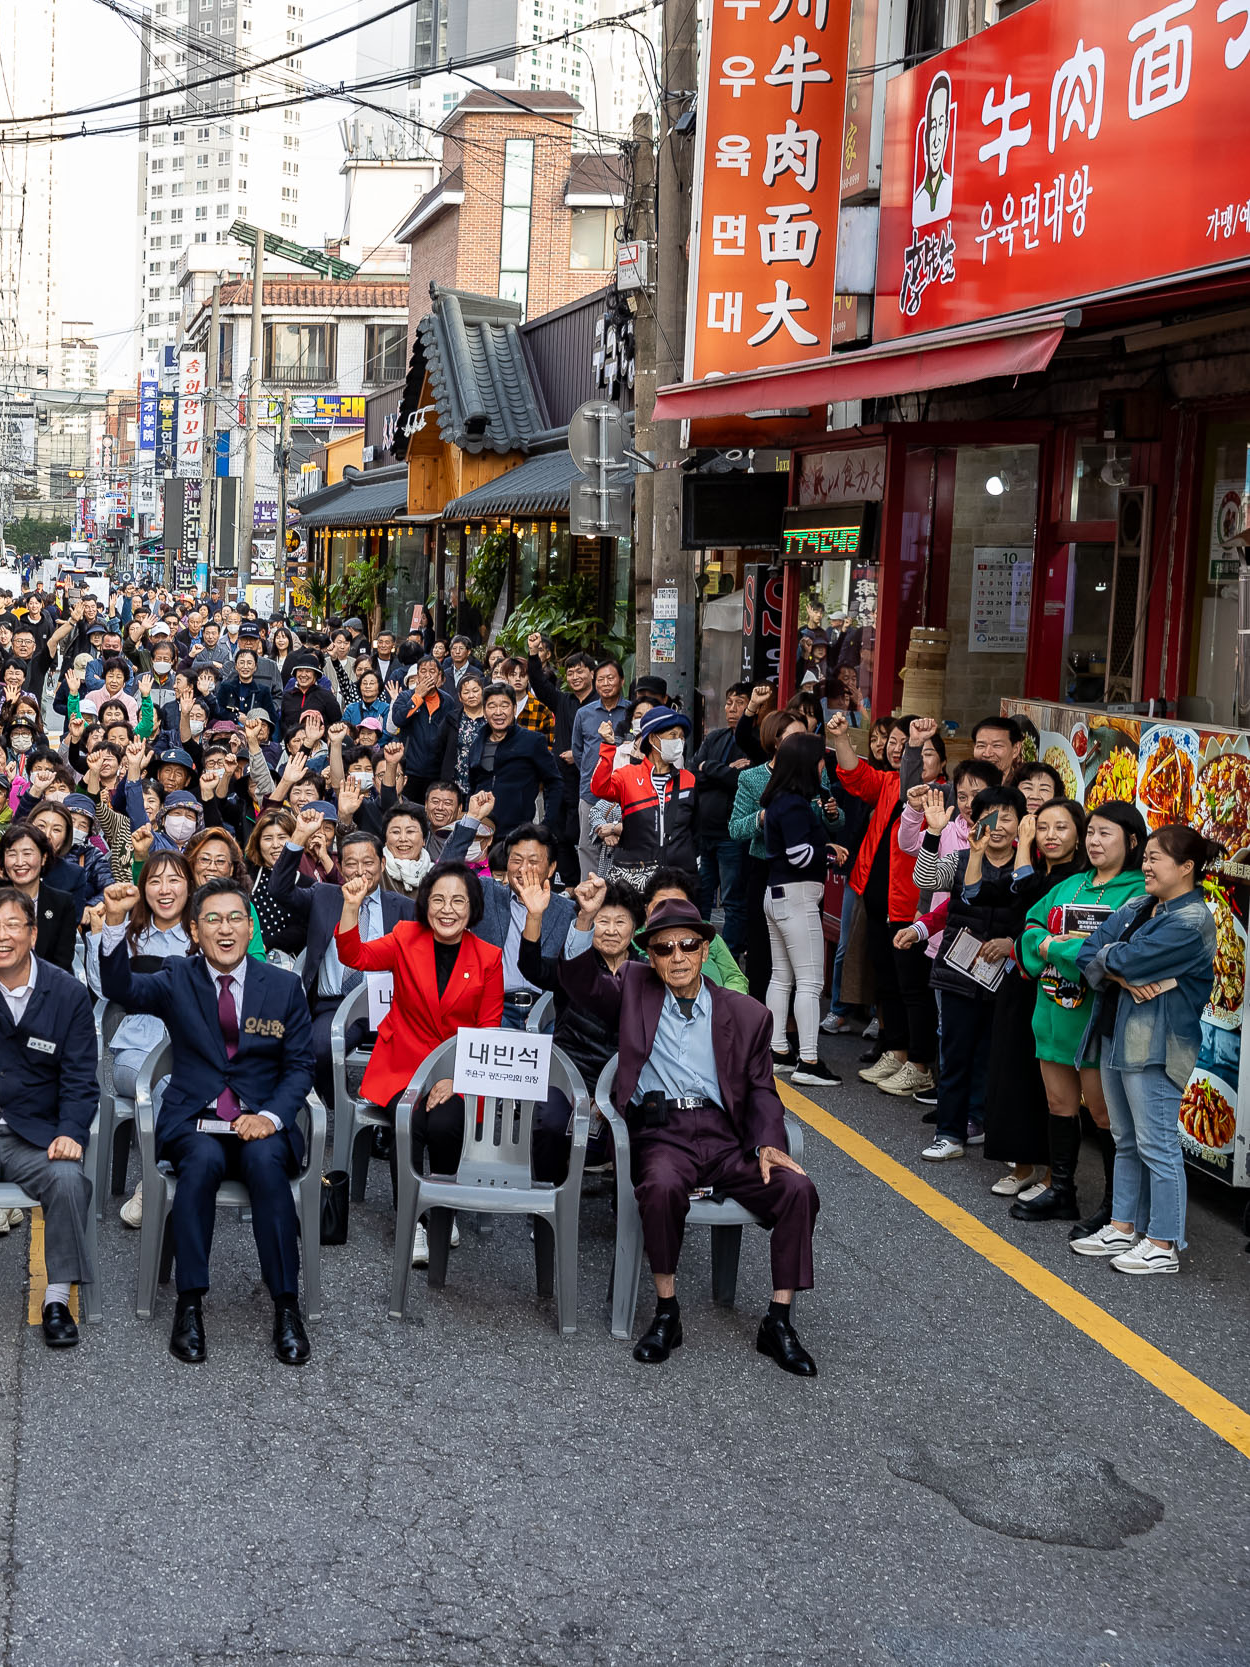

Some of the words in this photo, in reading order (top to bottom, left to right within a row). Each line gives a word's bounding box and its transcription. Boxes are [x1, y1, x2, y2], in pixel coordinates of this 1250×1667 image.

[706, 0, 761, 381] 우육면대
[746, 0, 833, 416] 牛肉面大
[975, 165, 1093, 265] 우육면대왕
[245, 1017, 285, 1039] 오신환
[469, 1042, 539, 1070] 내빈석
[489, 1072, 522, 1083] 광진구의회
[525, 1075, 539, 1084] 의장
